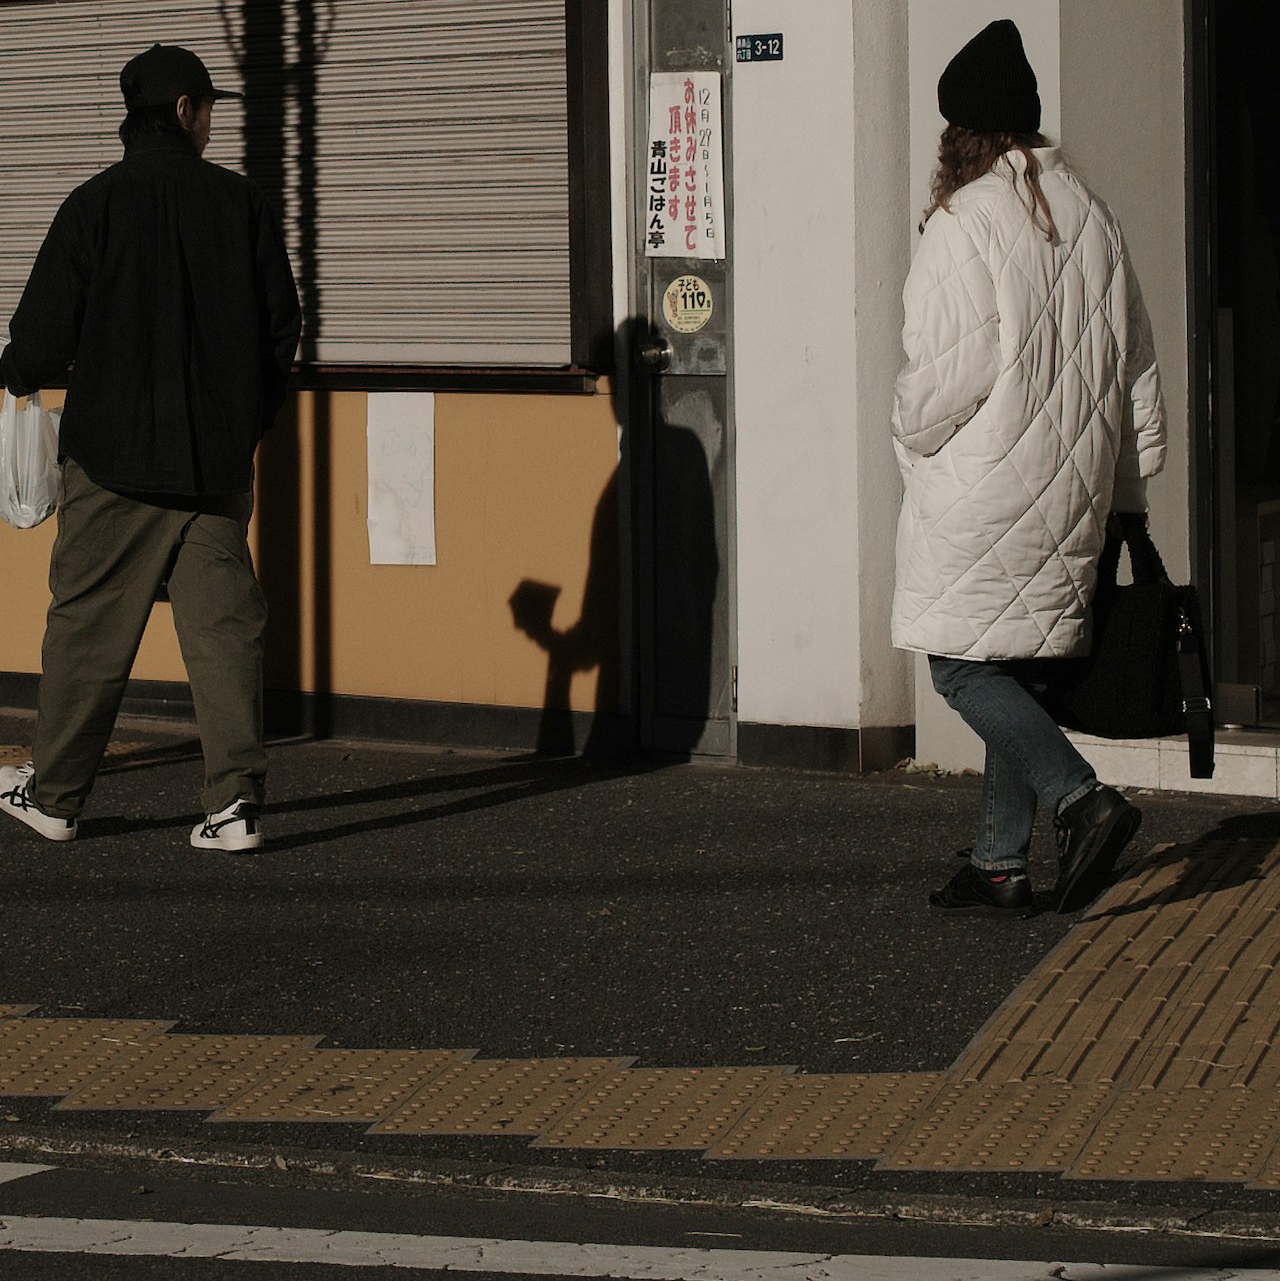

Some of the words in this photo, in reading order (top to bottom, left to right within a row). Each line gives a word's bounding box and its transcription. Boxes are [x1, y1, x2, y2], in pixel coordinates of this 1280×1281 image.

[754, 39, 780, 56] 3-12
[649, 140, 667, 249] 青山ごはん亭
[669, 105, 682, 220] 頂きます
[684, 78, 697, 250] お休みさせて
[678, 278, 699, 292] 子ども
